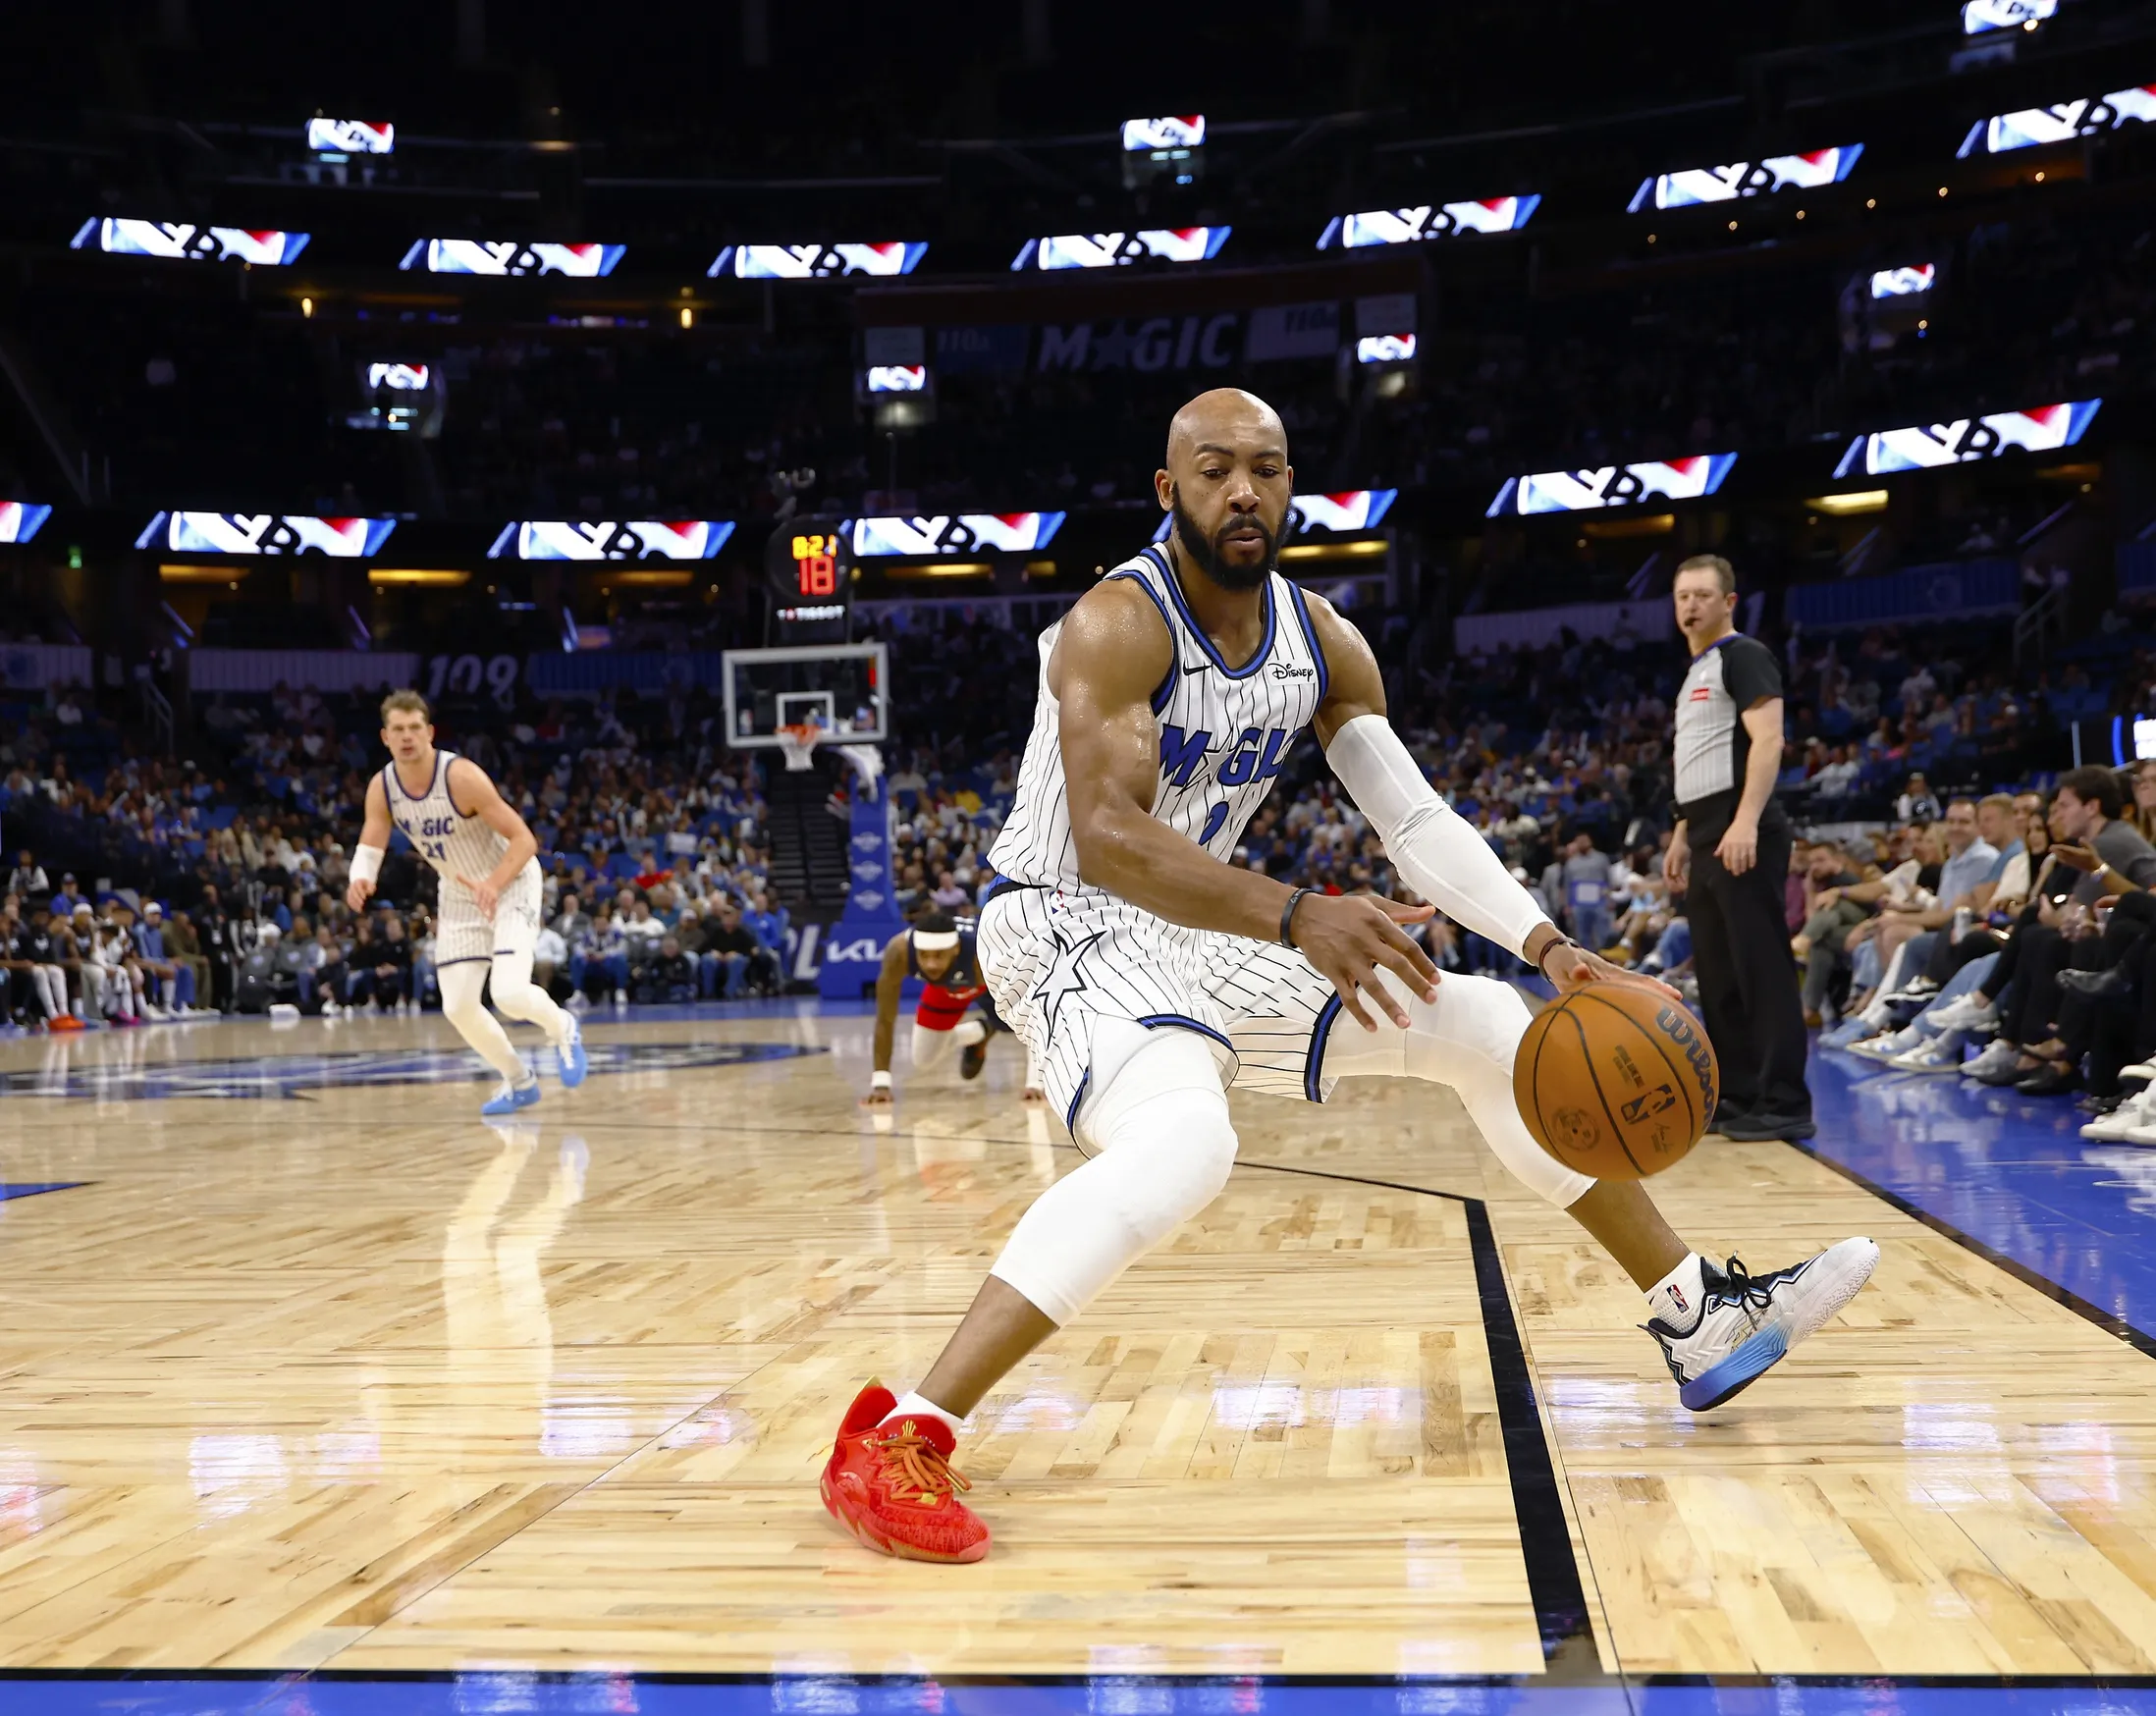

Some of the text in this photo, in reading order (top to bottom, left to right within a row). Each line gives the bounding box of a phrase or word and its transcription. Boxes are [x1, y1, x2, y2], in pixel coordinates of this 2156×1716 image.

[799, 555, 835, 596] 18
[427, 652, 518, 699] 109
[826, 938, 885, 963] KI
